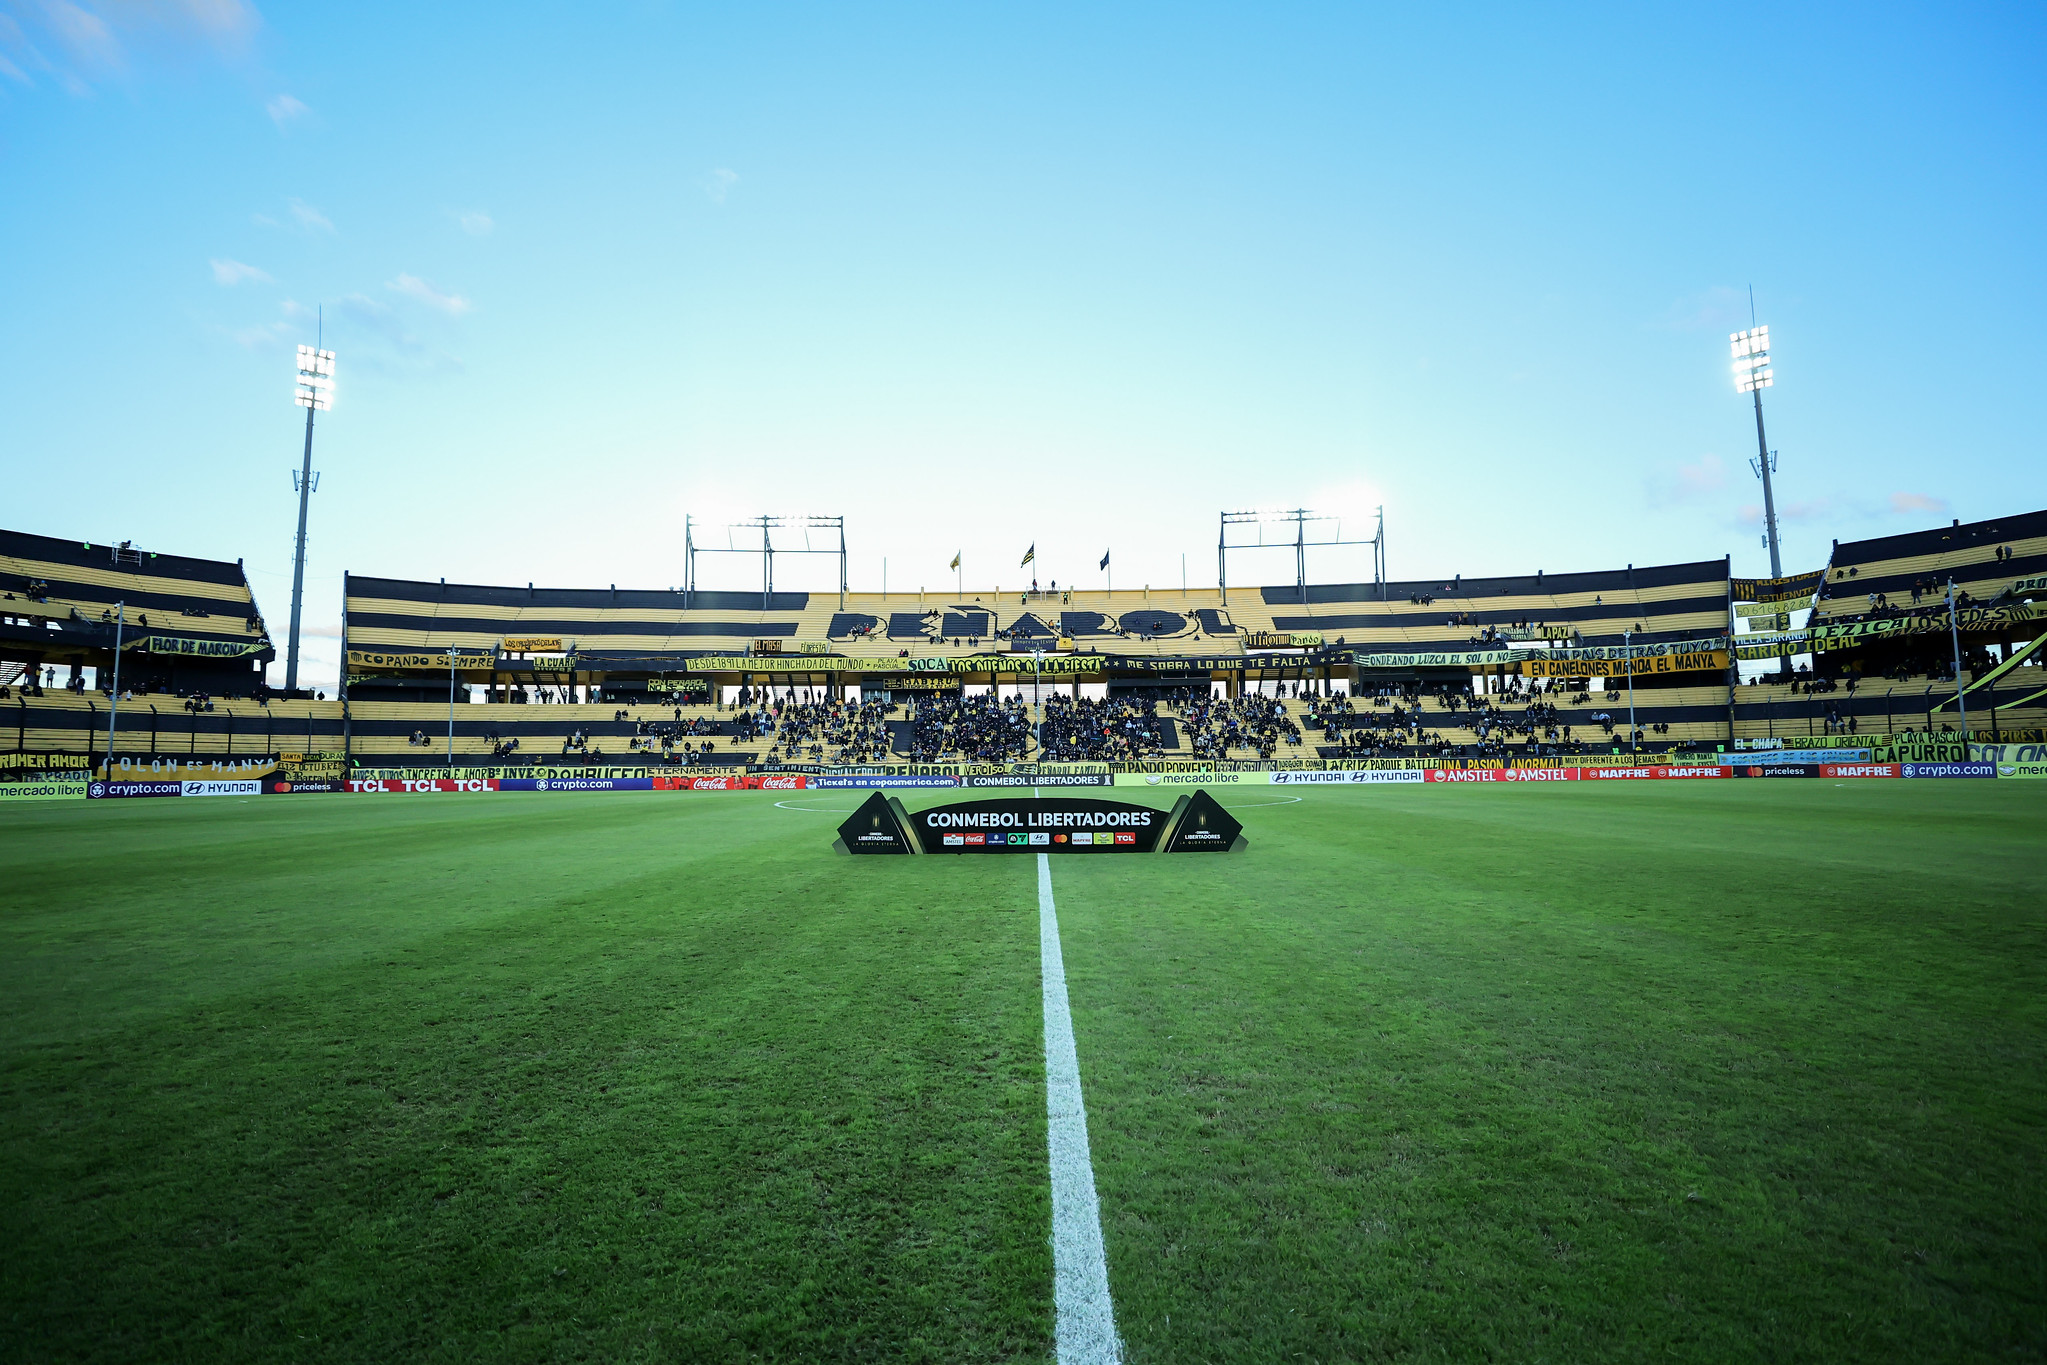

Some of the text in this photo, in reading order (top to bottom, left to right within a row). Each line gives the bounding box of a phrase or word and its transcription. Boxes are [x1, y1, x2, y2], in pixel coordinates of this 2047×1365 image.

[1736, 607, 1750, 616] 60
[1752, 605, 1765, 614] 61
[1767, 603, 1780, 613] 66
[1784, 601, 1796, 611] 82
[1811, 618, 1905, 638] LEZICA
[152, 637, 179, 651] FLOR
[181, 640, 195, 653] DE
[763, 640, 781, 650] MASA
[1291, 634, 1319, 645] Pando
[1734, 634, 1762, 645] VILLA
[1737, 637, 1861, 660] BARRIO IDEAL
[364, 654, 429, 667] COPANDO
[535, 658, 545, 667] LA
[689, 658, 863, 669] DESDE 1891 LA MEJOR HINCHADA DEL MUNDO
[908, 658, 946, 671] SOCA
[1127, 657, 1310, 670] ME SOBRA LO QUE TE FALTA
[1371, 655, 1414, 666] ONDEANDO
[1417, 654, 1446, 664] LUZCA
[1450, 654, 1461, 664] EL
[1465, 653, 1482, 663] SOL
[1496, 652, 1509, 661] NO
[1532, 654, 1716, 676] EN CANELONES MANDA EL MANYA
[951, 660, 973, 673] LOS
[1044, 659, 1060, 674] LA
[1063, 658, 1101, 673] FIESTA
[1735, 738, 1782, 750] EL CHAPA
[1795, 736, 1882, 748] BRAZO ORIENTAL
[1894, 732, 1925, 744] PLAYA
[1581, 756, 1614, 764] DIFERENTE
[1616, 756, 1620, 764] A
[1621, 755, 1633, 764] LOS
[1874, 745, 1965, 763] CAPURRO
[50, 754, 89, 768] AMOR
[186, 761, 203, 771] ES
[211, 758, 275, 773] MANYA
[299, 762, 338, 771] OCTUBRE
[1128, 761, 1164, 773] PANDO
[1371, 758, 1438, 770] PARQUE BATLLE
[1440, 758, 1560, 769] UNA PASION ANORMAL
[464, 768, 487, 779] AMOR
[1371, 772, 1421, 781] HYUNDAI
[1448, 770, 1495, 781] AMSTEL
[1519, 769, 1567, 781] AMSTEL
[1600, 769, 1650, 778] MAPFRE
[1669, 768, 1721, 777] MAPFRE
[1765, 767, 1805, 776] priceless
[1838, 767, 1892, 776] MAPFRE
[1919, 765, 1993, 777] crypto.com
[693, 778, 727, 790] Coca-Cola
[763, 777, 796, 789] Coca-Cola
[818, 778, 853, 786] Tickets
[870, 779, 954, 788] copaamerica.com
[974, 776, 1098, 786] CONMEBOL LIBERTADORES
[1163, 773, 1239, 783] mercado libre
[1295, 774, 1345, 782] HYUNDAI
[0, 782, 85, 796] mercado libre
[109, 783, 180, 796] crypto.com
[208, 783, 257, 793] HYUNDAI
[293, 782, 331, 791] priceless
[350, 780, 389, 792] TCL
[401, 780, 443, 792] TCL
[453, 779, 494, 792] TCL
[551, 780, 613, 790] crypto.com
[927, 812, 1151, 827] CONMEBOL LIBERTADORES
